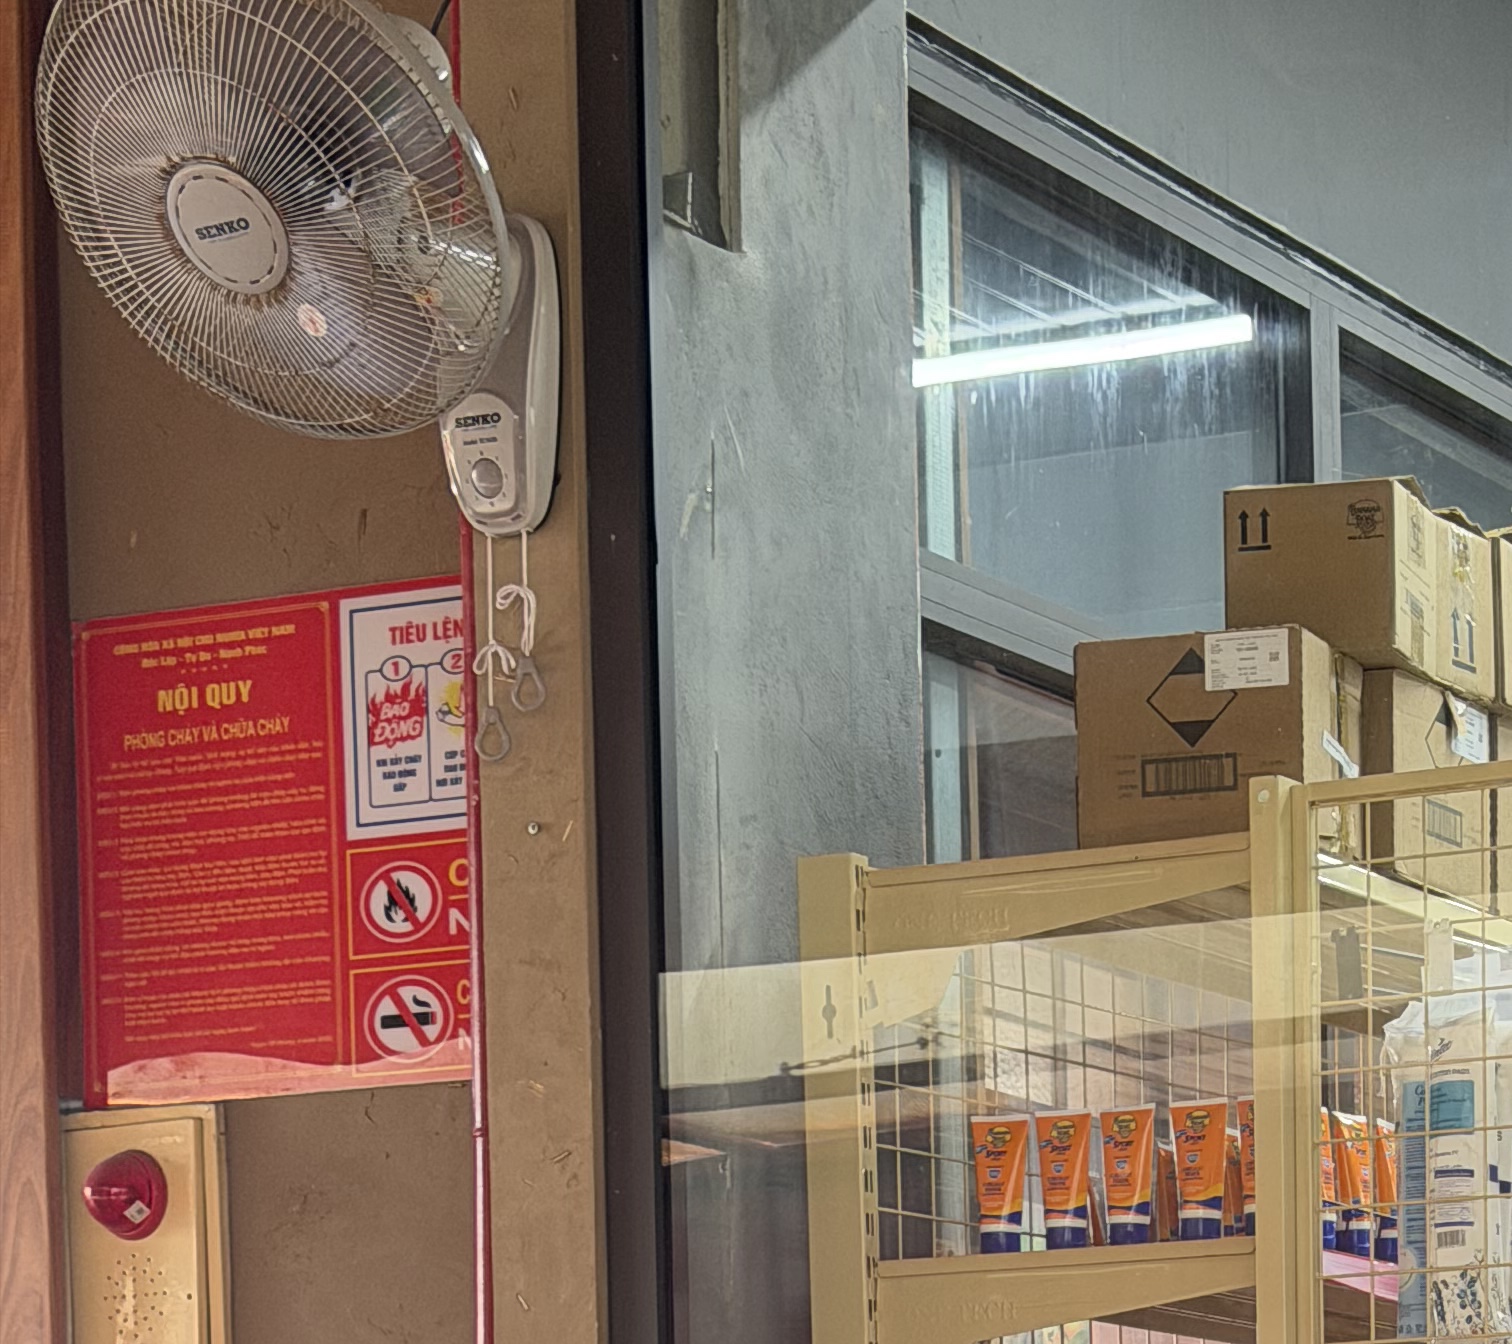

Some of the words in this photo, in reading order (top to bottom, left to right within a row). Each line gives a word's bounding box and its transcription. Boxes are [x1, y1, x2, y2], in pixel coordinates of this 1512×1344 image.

[195, 217, 250, 241] SENKO
[455, 412, 501, 428] SENKO
[389, 621, 427, 646] TIÊU
[391, 661, 400, 677] 1
[157, 683, 199, 715] NỘI
[205, 680, 252, 709] QUY
